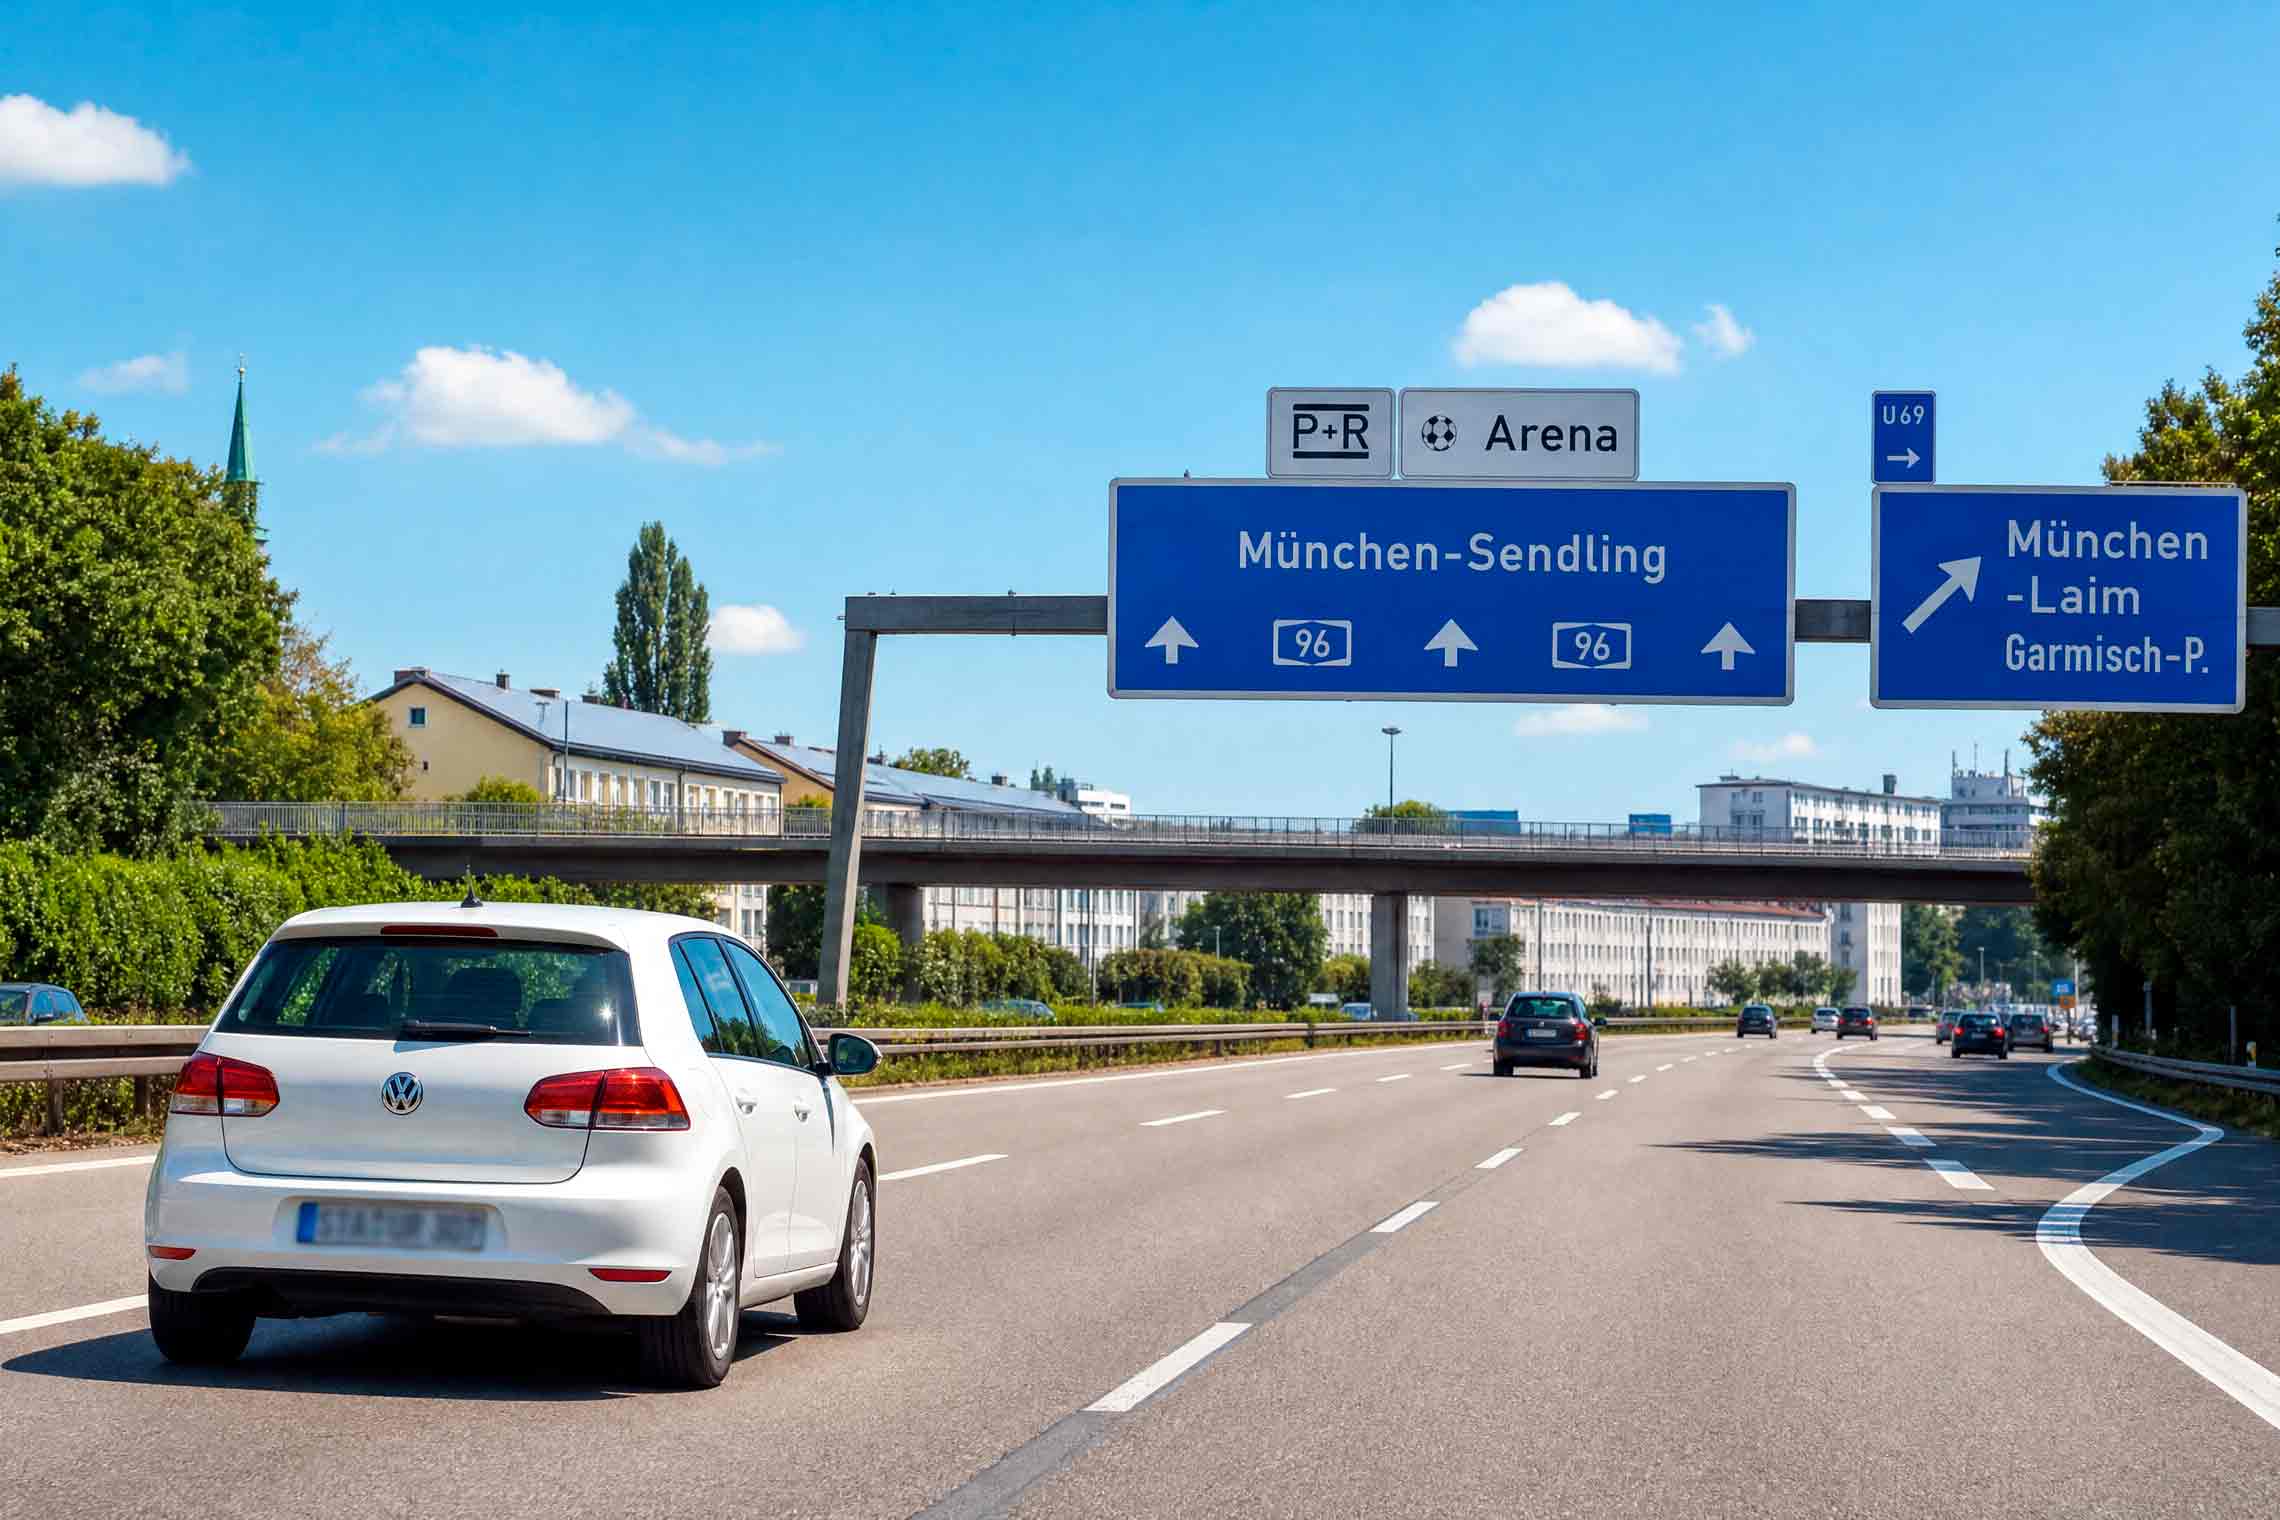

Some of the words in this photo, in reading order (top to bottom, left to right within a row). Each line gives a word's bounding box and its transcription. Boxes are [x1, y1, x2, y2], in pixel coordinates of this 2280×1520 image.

[1293, 413, 1369, 449] P+R
[1484, 414, 1618, 452] Arena
[1238, 531, 1667, 584] München-Sendling
[2007, 519, 2209, 560] München
[2006, 575, 2141, 615] -Laim
[1295, 629, 1331, 659] 96
[1574, 631, 1611, 661] 96
[2005, 633, 2210, 674] Garmisch-P.
[383, 1073, 423, 1115] VW
